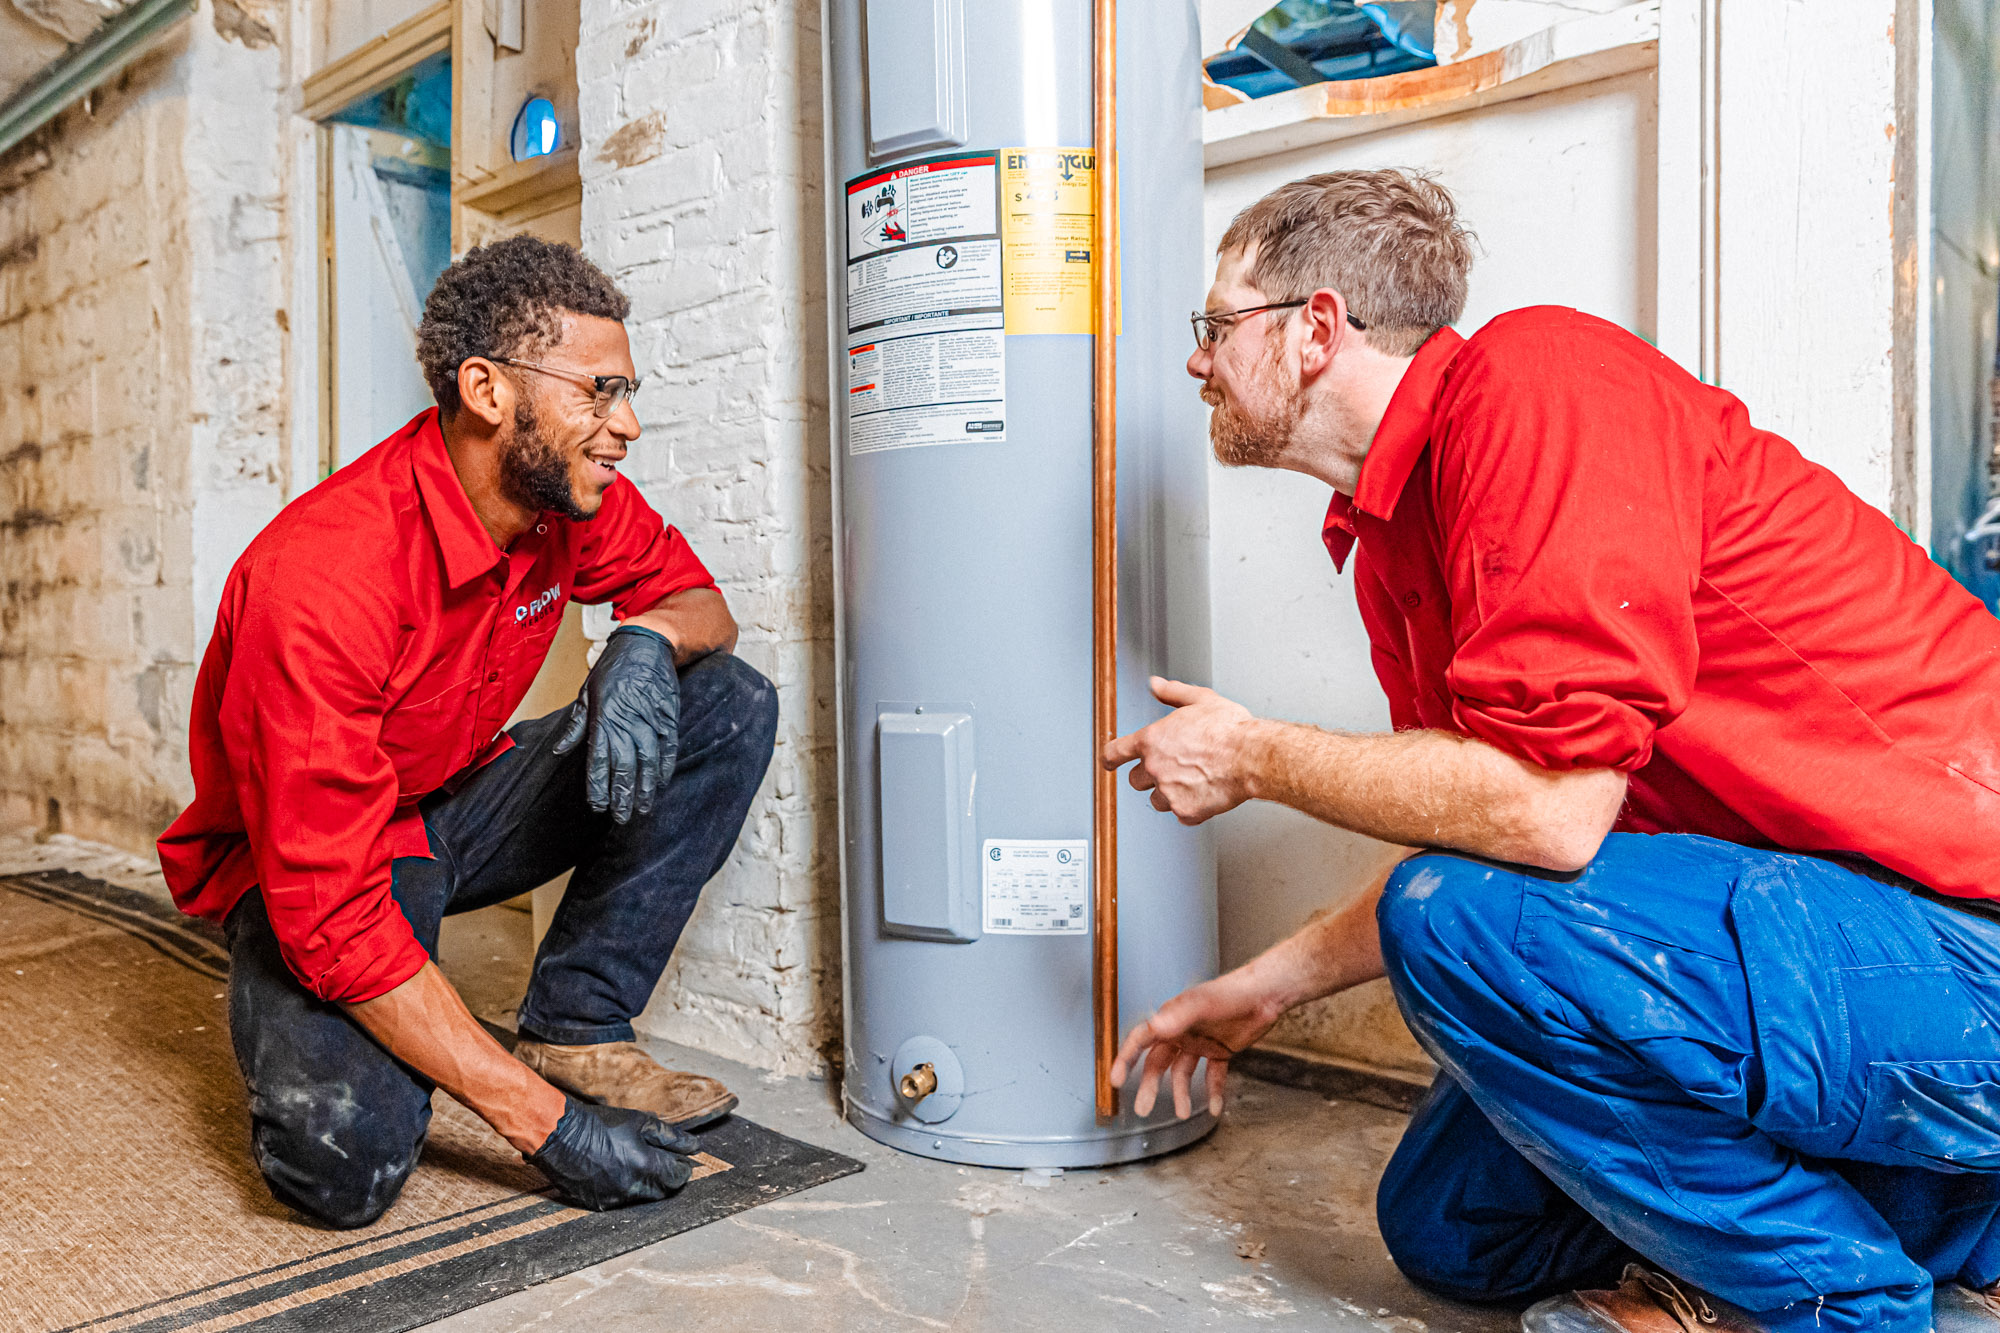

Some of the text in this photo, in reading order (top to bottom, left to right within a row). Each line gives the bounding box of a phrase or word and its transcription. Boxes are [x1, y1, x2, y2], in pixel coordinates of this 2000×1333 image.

[899, 166, 929, 177] DANGER
[884, 316, 911, 325] IMPORTANT
[915, 311, 949, 319] IMPORTANTE
[530, 582, 560, 616] FLOW
[521, 604, 554, 630] HEROES
